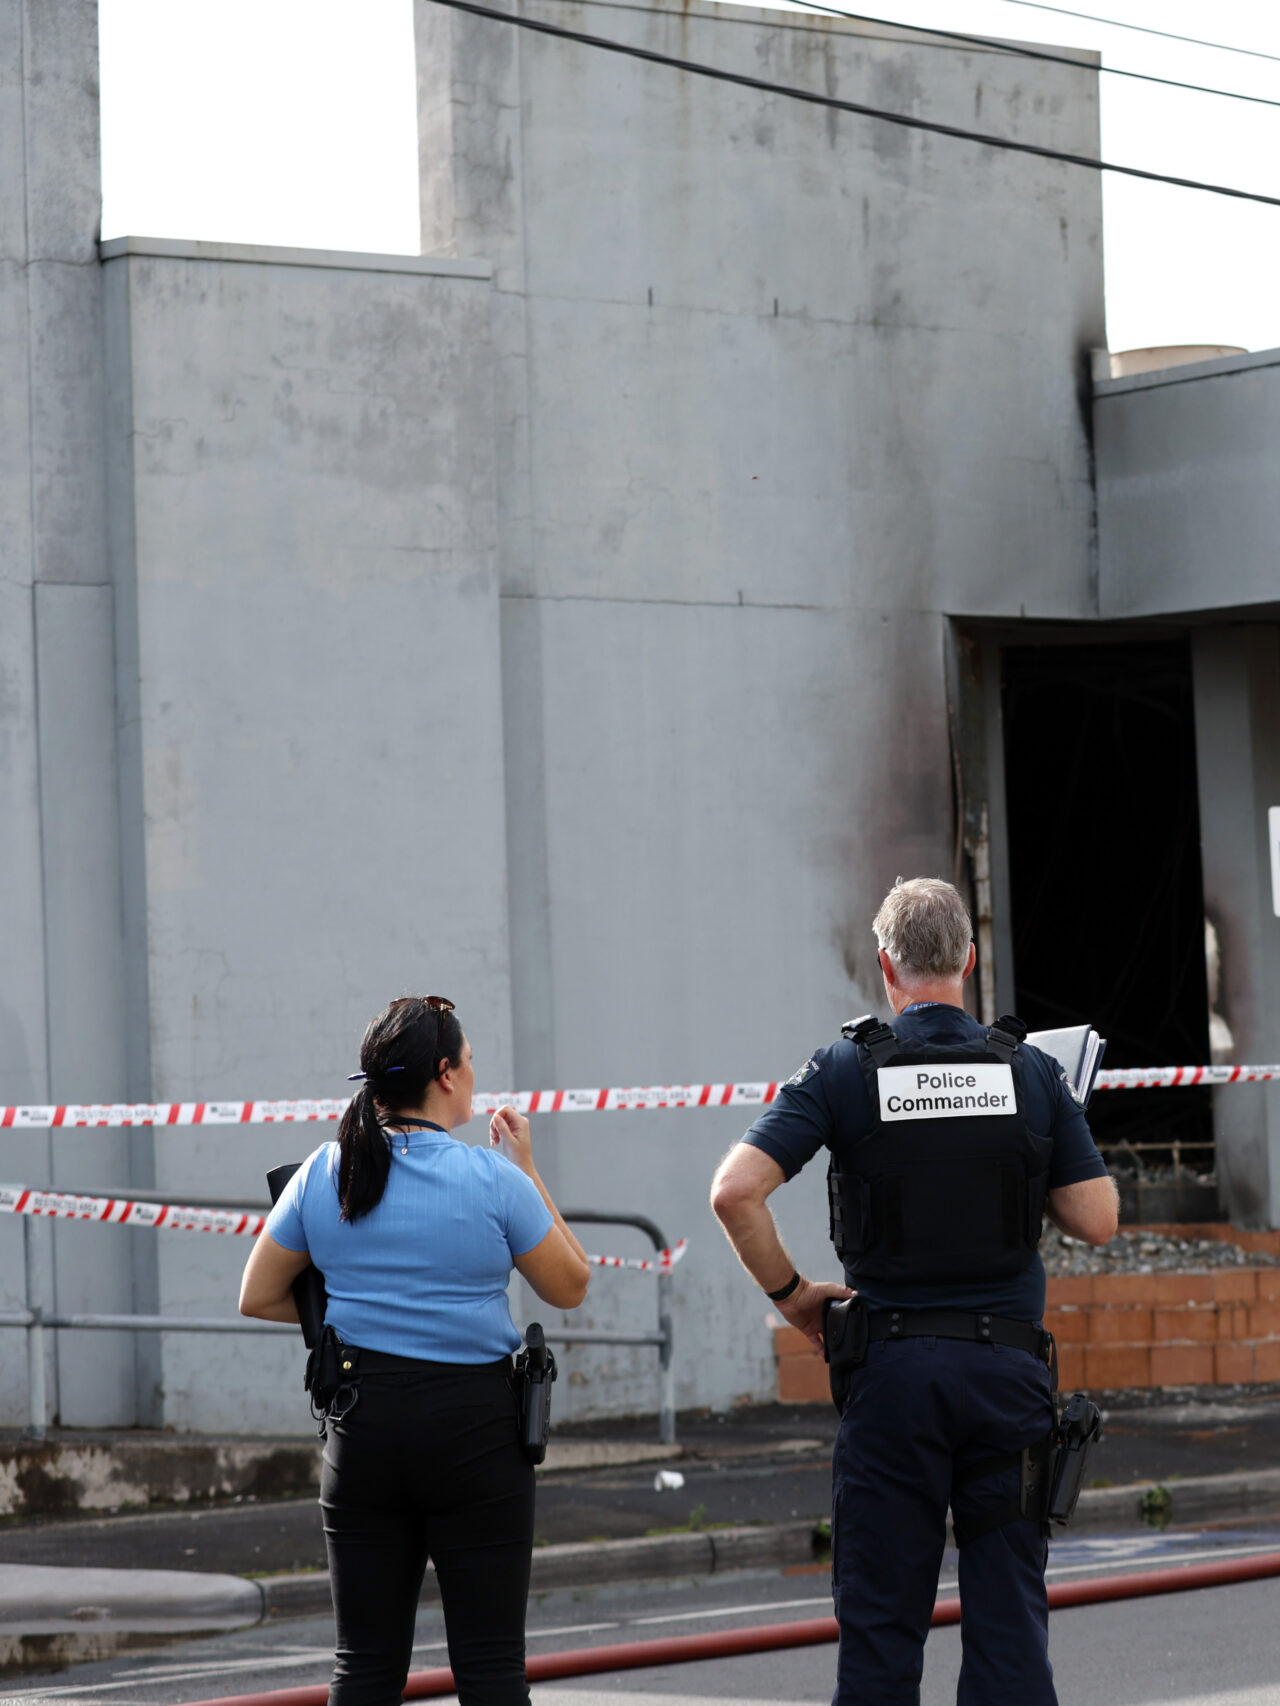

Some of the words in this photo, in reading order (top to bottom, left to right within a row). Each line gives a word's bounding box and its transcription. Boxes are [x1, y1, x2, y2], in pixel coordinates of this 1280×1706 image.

[917, 1073, 976, 1090] Police
[616, 1091, 669, 1102] RESTRICTED
[671, 1090, 692, 1099] AREA
[887, 1092, 1008, 1112] Commander
[75, 1109, 132, 1119] RESTRICTED
[134, 1109, 159, 1118] AREA
[34, 1197, 77, 1211] RESTRICTED
[79, 1202, 97, 1213] AREA
